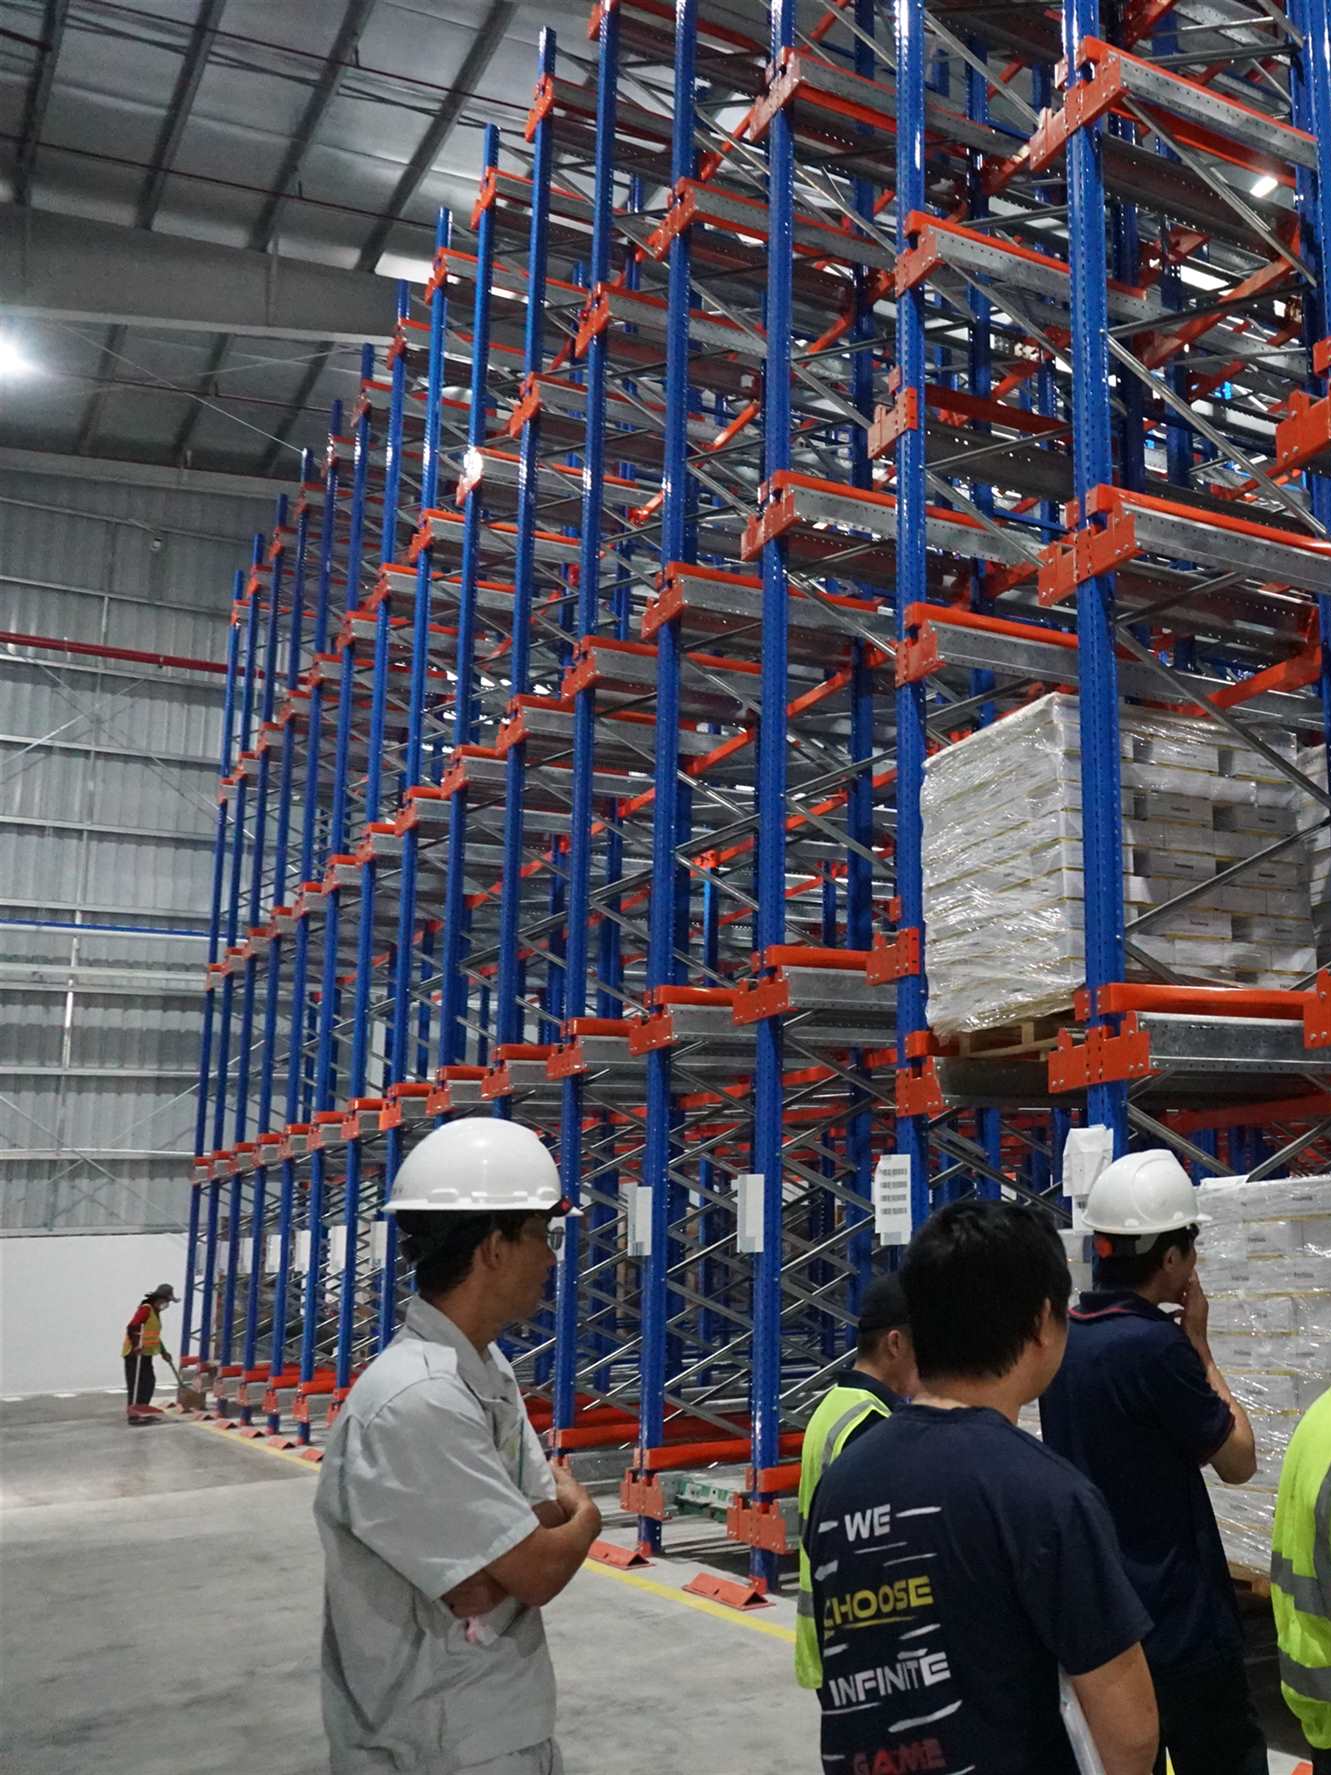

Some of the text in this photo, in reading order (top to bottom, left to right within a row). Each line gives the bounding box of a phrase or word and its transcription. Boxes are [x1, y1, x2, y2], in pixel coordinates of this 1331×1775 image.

[844, 1504, 891, 1541] WE
[829, 1651, 951, 1707] INFINITE
[853, 1738, 946, 1775] GAME
